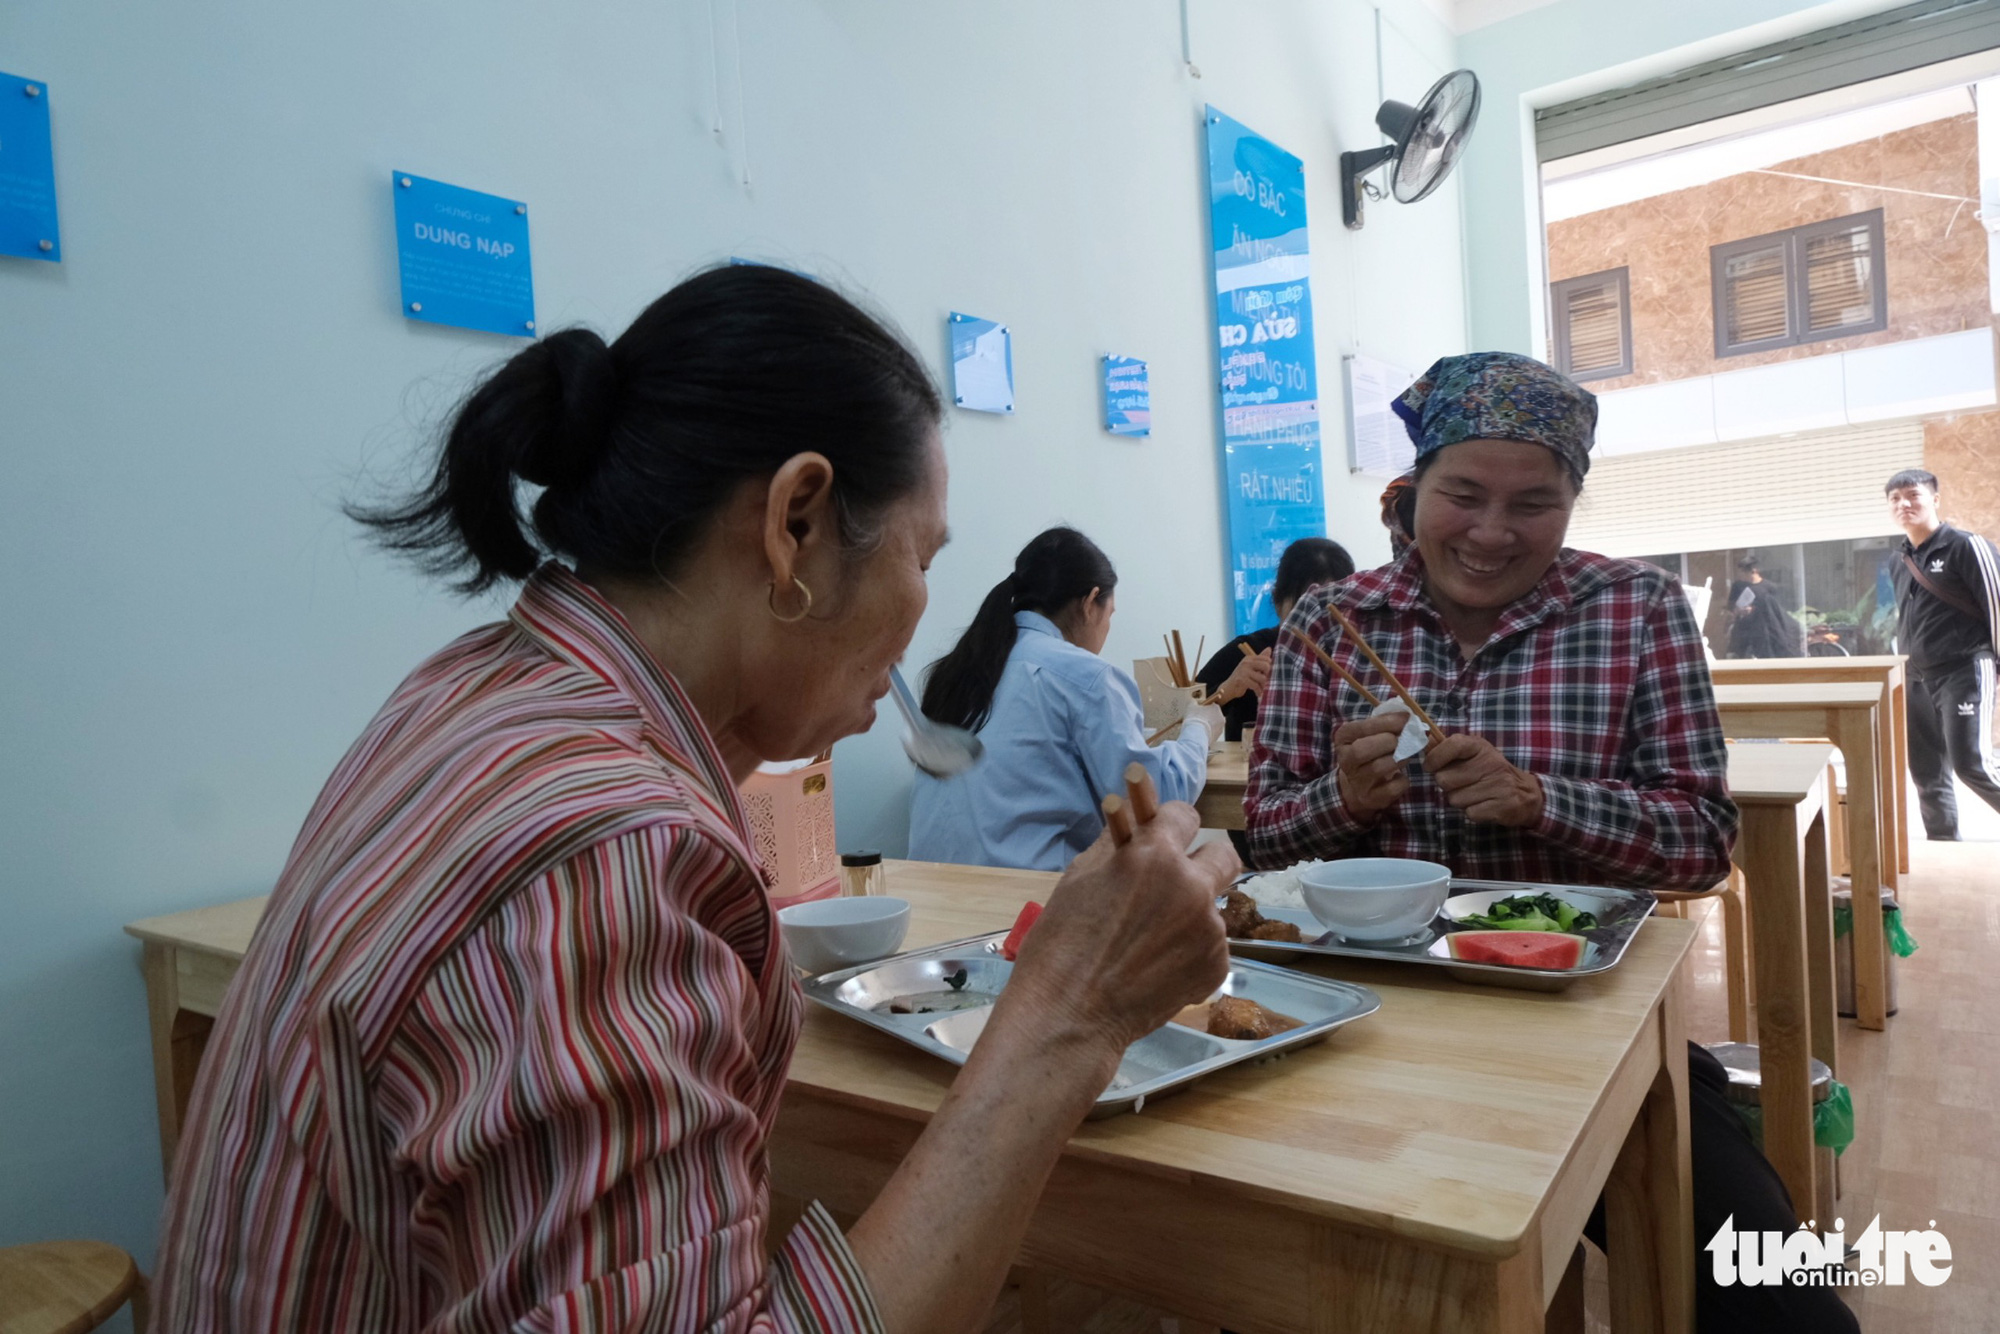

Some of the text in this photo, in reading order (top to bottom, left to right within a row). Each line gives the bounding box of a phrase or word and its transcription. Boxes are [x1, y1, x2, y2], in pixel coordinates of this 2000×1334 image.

[1233, 170, 1287, 217] CÔ BÁC
[414, 222, 514, 260] DUNG NẠP
[1232, 222, 1252, 259] ĂN
[1285, 361, 1307, 391] TÔI
[1240, 467, 1313, 503] RẤT NHIỀU
